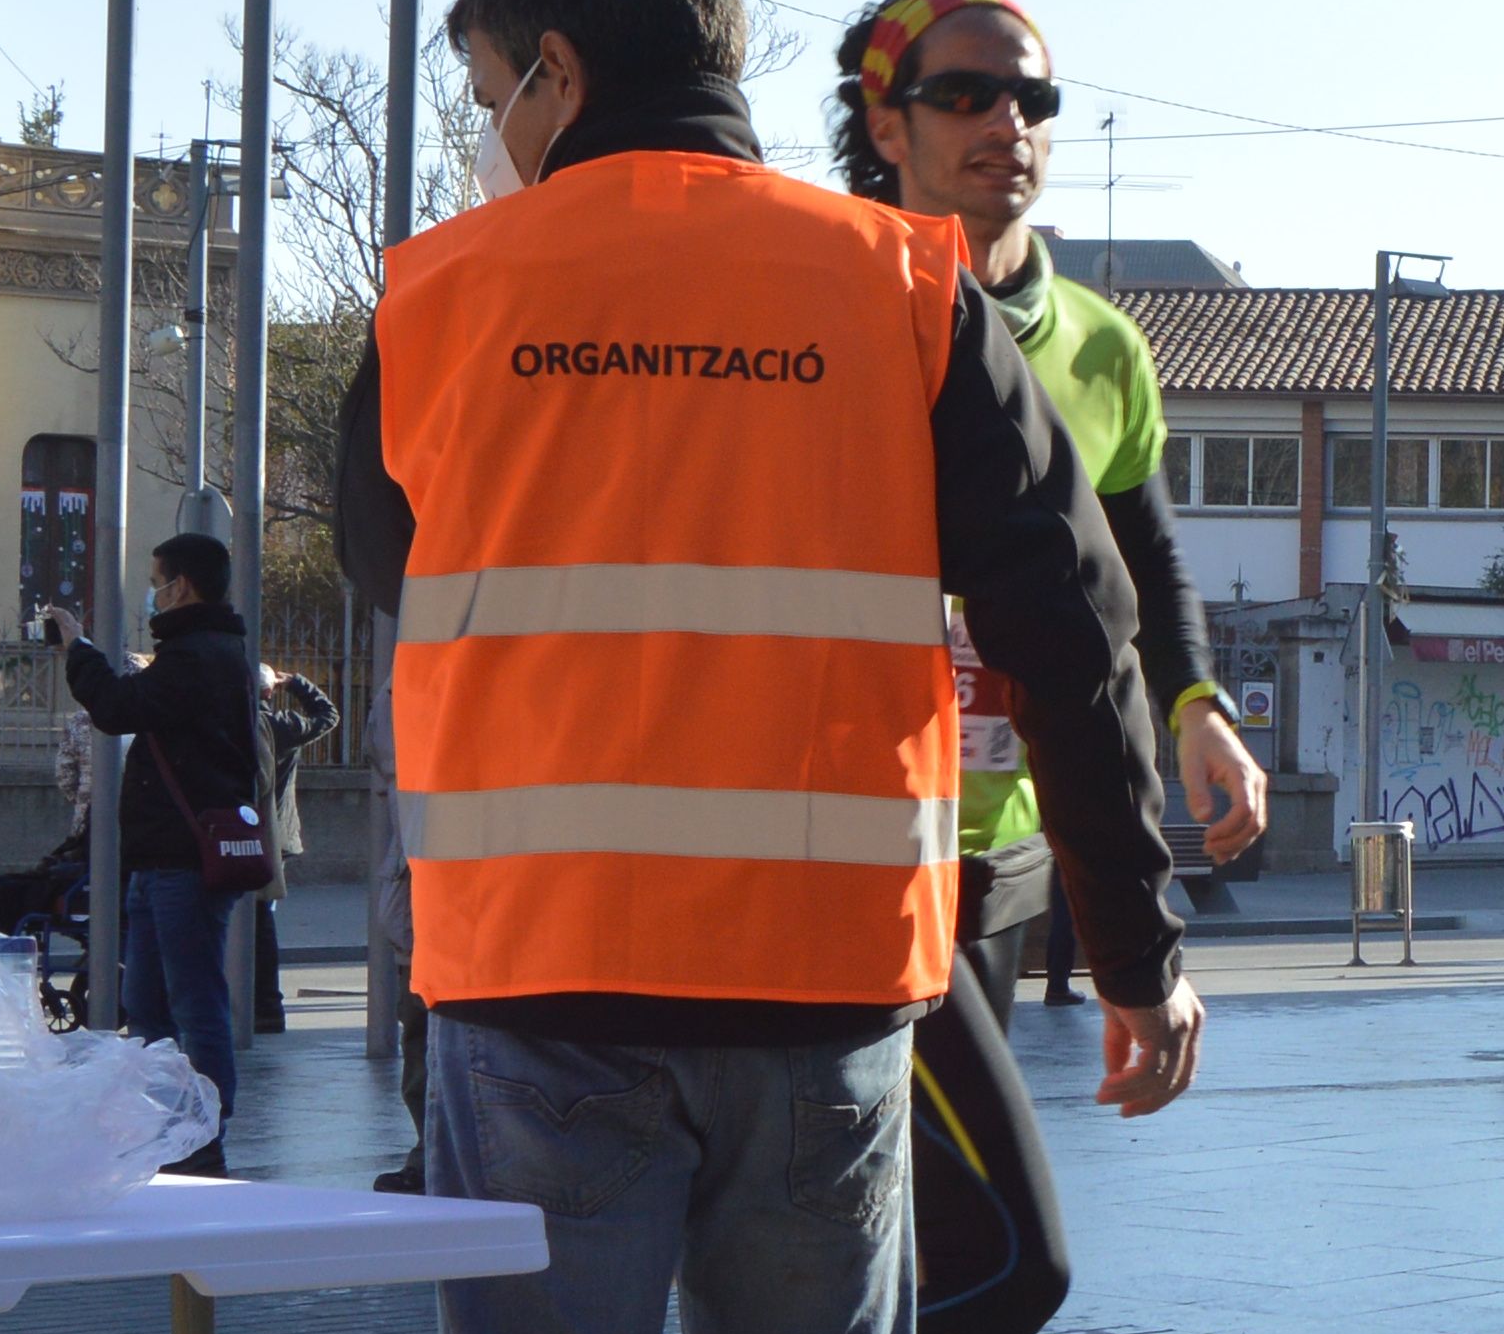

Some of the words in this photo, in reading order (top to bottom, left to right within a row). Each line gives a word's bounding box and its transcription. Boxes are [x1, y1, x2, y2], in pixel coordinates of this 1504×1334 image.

[511, 341, 826, 384] ORGANITZACIÓ
[1464, 641, 1481, 663] el
[220, 839, 263, 857] PUMA
